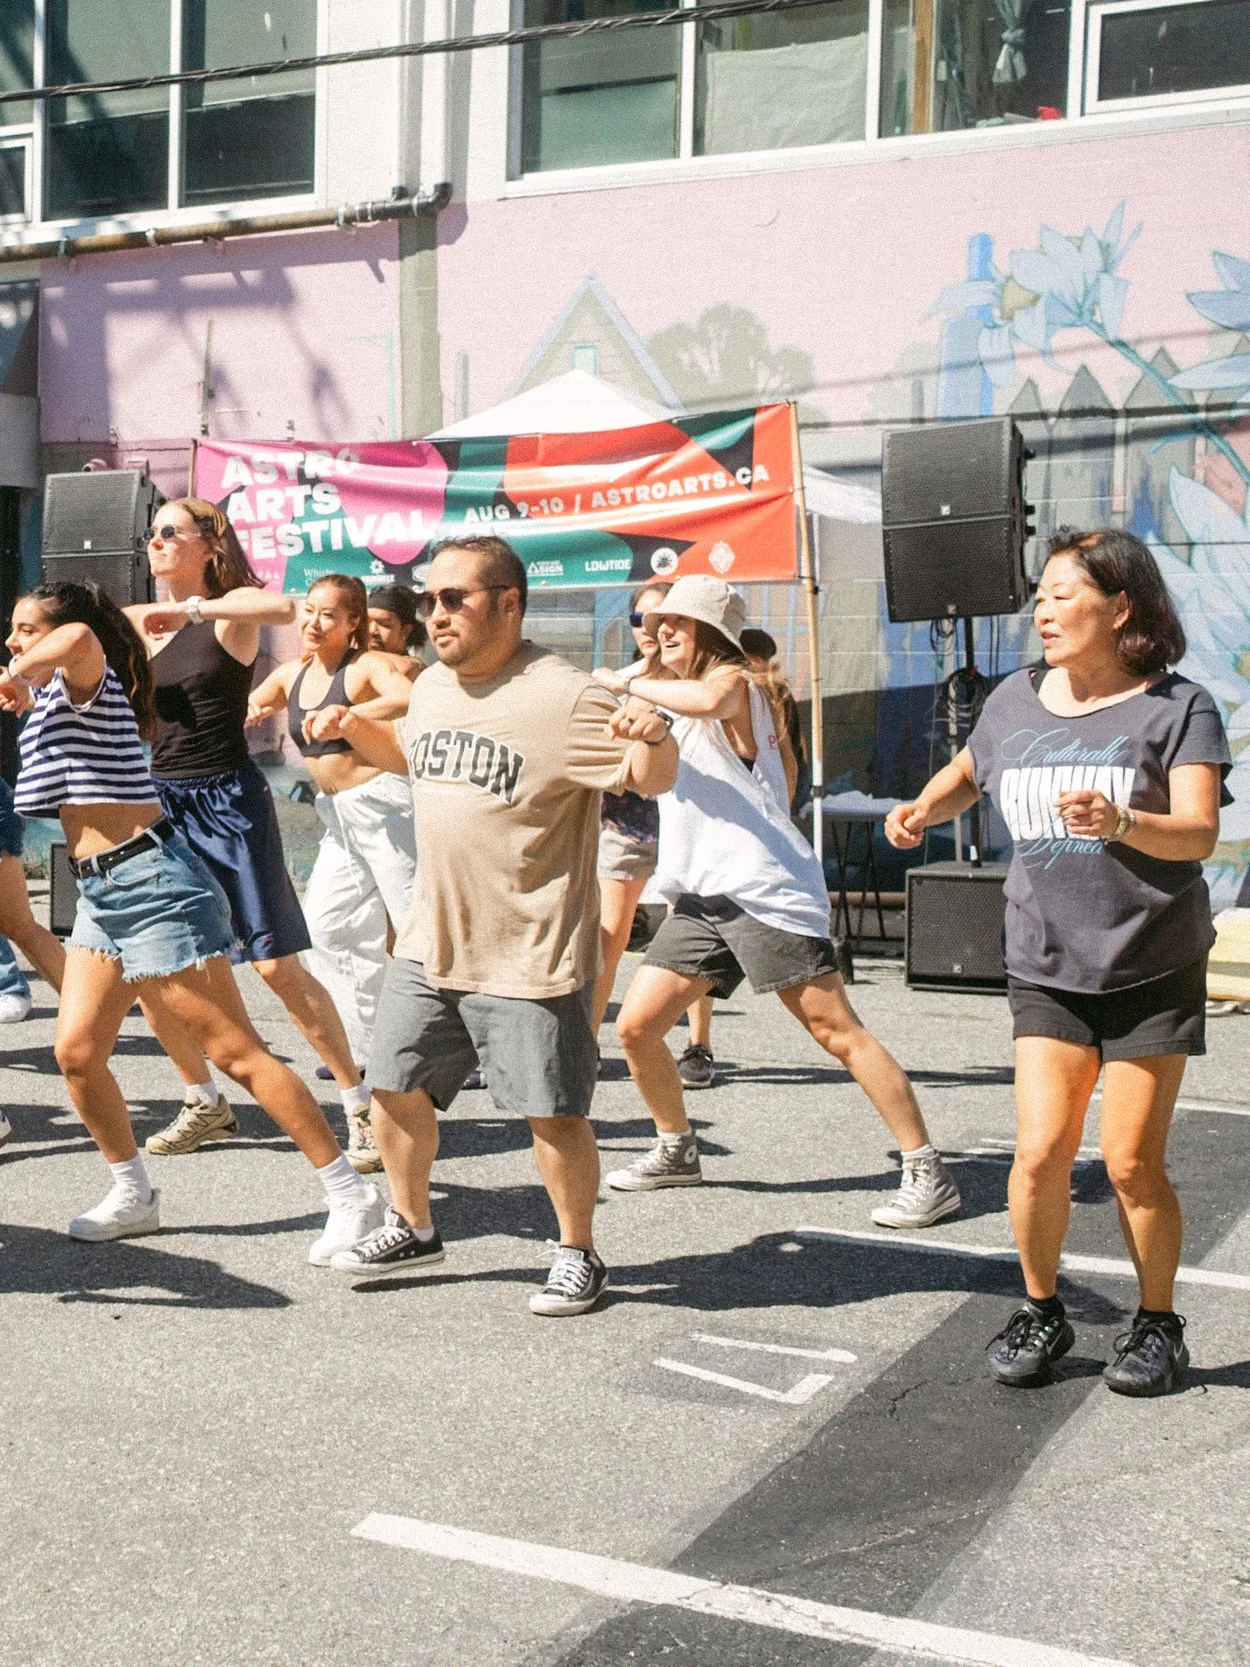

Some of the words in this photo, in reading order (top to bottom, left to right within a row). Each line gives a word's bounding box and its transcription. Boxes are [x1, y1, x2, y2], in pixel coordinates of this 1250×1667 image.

[221, 448, 361, 489] ASTRO
[226, 483, 342, 525] ARTS
[465, 505, 511, 524] AUG
[517, 500, 565, 518] 9-10
[591, 464, 770, 509] ASTROARTS.CA
[1001, 727, 1130, 768] Culturally
